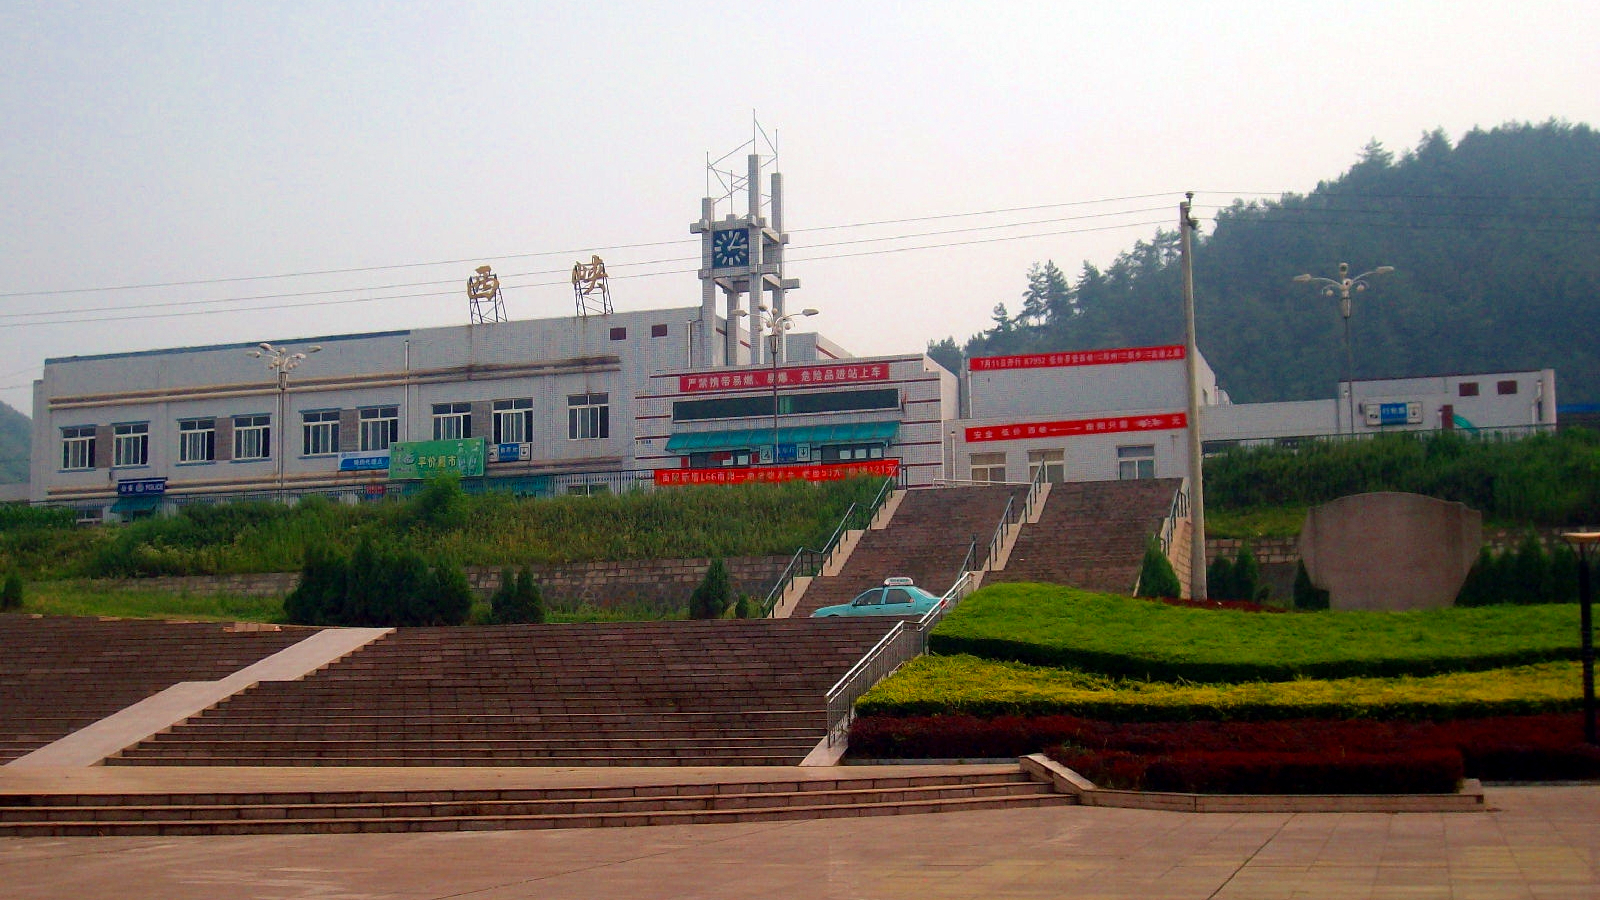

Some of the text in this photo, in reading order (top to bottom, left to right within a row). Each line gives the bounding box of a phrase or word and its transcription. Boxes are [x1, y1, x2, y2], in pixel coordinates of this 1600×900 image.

[417, 455, 458, 468] 平价超市
[145, 483, 164, 491] POLICE
